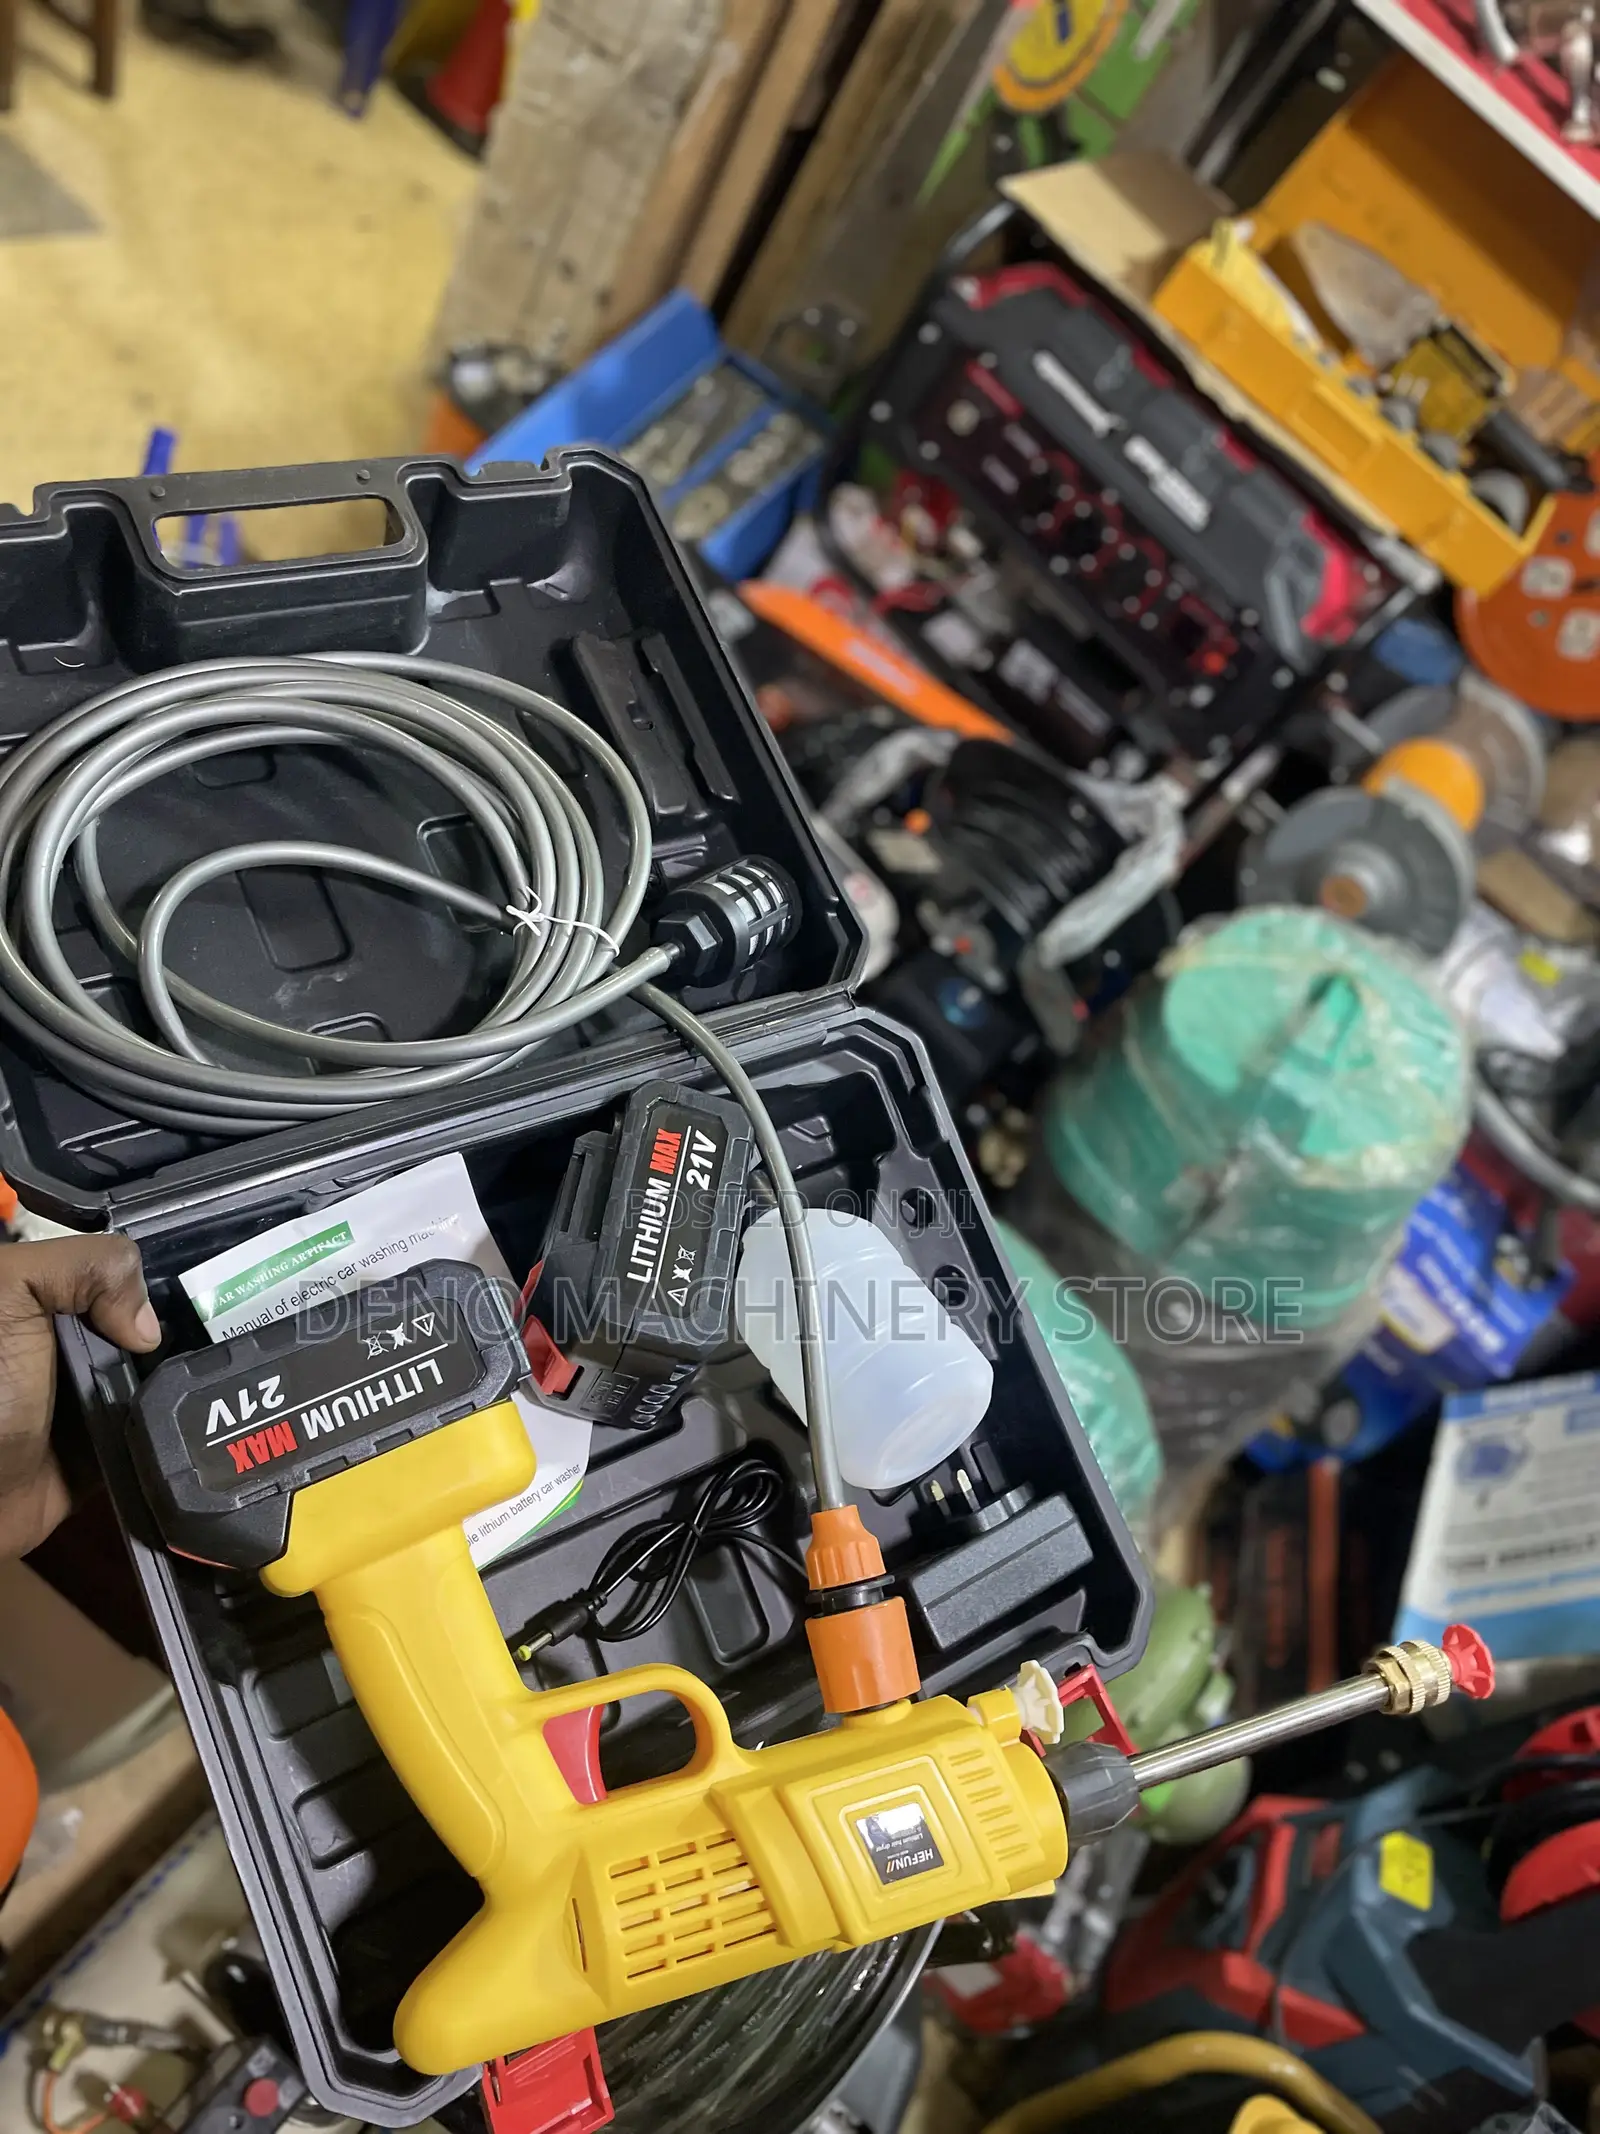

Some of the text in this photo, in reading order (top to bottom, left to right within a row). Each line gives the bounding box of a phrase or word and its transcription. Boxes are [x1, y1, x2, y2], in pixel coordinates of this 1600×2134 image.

[686, 1130, 717, 1191] 21V
[627, 1128, 683, 1284] LITHIUM MAX
[221, 1310, 275, 1341] Manual
[275, 1297, 291, 1318] of
[291, 1273, 338, 1308] electric
[337, 1263, 358, 1282] car
[358, 1236, 410, 1268] washing
[233, 1260, 290, 1299] WASHING
[291, 1230, 349, 1270] ARTIFACT
[205, 1374, 286, 1437] 21V
[225, 1358, 445, 1475] LITHIUM MAX
[478, 1511, 511, 1539] lithium
[508, 1490, 541, 1516] battery
[541, 1480, 555, 1495] car
[554, 1463, 582, 1485] washer
[891, 1839, 903, 1848] hair
[902, 1832, 924, 1845] Lithium
